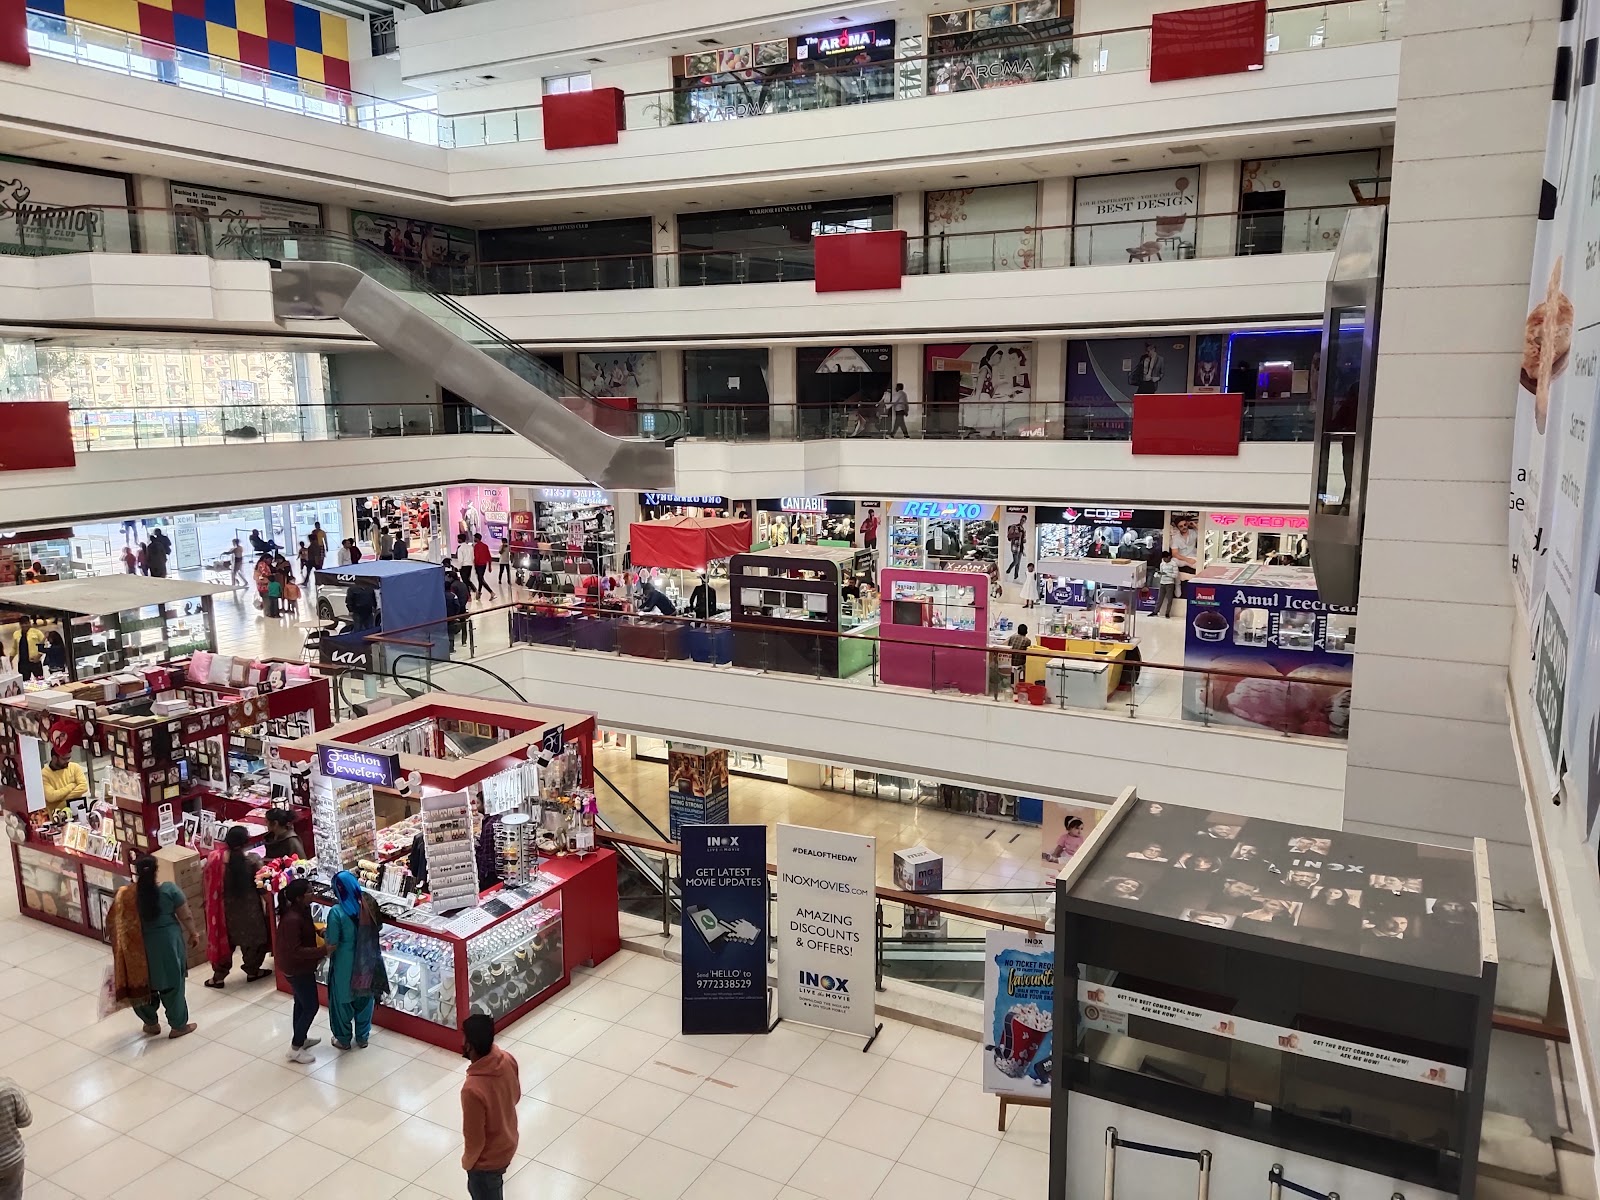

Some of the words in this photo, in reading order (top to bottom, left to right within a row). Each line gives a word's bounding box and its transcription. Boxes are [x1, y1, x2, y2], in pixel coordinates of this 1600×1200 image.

[805, 37, 818, 45] The
[820, 30, 870, 51] AROMA
[961, 58, 1035, 90] AROMA
[1097, 202, 1134, 215] BEST
[1137, 195, 1195, 211] DESIGN
[15, 202, 99, 233] WARRIOR
[780, 496, 827, 511] CANTABIL
[903, 501, 981, 519] RELAXO
[1196, 592, 1215, 601] Amul
[1231, 589, 1279, 607] Amul
[1285, 594, 1358, 613] Icecrea
[1268, 612, 1280, 645] Amul
[1315, 615, 1327, 649] Amul
[327, 749, 381, 767] Fashion
[326, 761, 387, 785] Jewelery
[685, 800, 704, 809] STRONG
[707, 836, 739, 847] INOX
[792, 847, 858, 863] #DEALOFTHEDAY
[907, 850, 928, 859] max
[695, 868, 715, 877] GET
[717, 867, 752, 877] LATEST
[1292, 859, 1365, 874] INOX
[685, 878, 716, 887] MOVIE
[718, 877, 762, 887] UPDATES
[782, 872, 868, 896] INOXMOVIES.COM
[796, 907, 853, 926] AMAZING
[790, 920, 860, 943] DISCOUNTS
[795, 937, 804, 948] &
[806, 939, 853, 957] OFFERS!
[1004, 959, 1014, 967] NO
[1015, 960, 1038, 969] TICKET
[709, 969, 742, 978] 'HELLO'
[799, 970, 849, 993] INOX
[696, 979, 752, 989] 9772338529
[799, 988, 816, 996] LIVE
[825, 993, 850, 1002] MOVIE
[1139, 998, 1152, 1006] BEST
[1152, 1002, 1172, 1012] COMBO
[1172, 1006, 1186, 1015] DEAL
[1187, 1009, 1203, 1018] NOW!
[1141, 1006, 1152, 1014] ASK
[1161, 1011, 1177, 1019] NOW!
[1337, 1045, 1352, 1053] BEST
[1353, 1048, 1375, 1058] COMBO
[1375, 1053, 1391, 1062] DEAL
[1392, 1056, 1410, 1066] NOW!
[1363, 1058, 1380, 1066] NOW!
